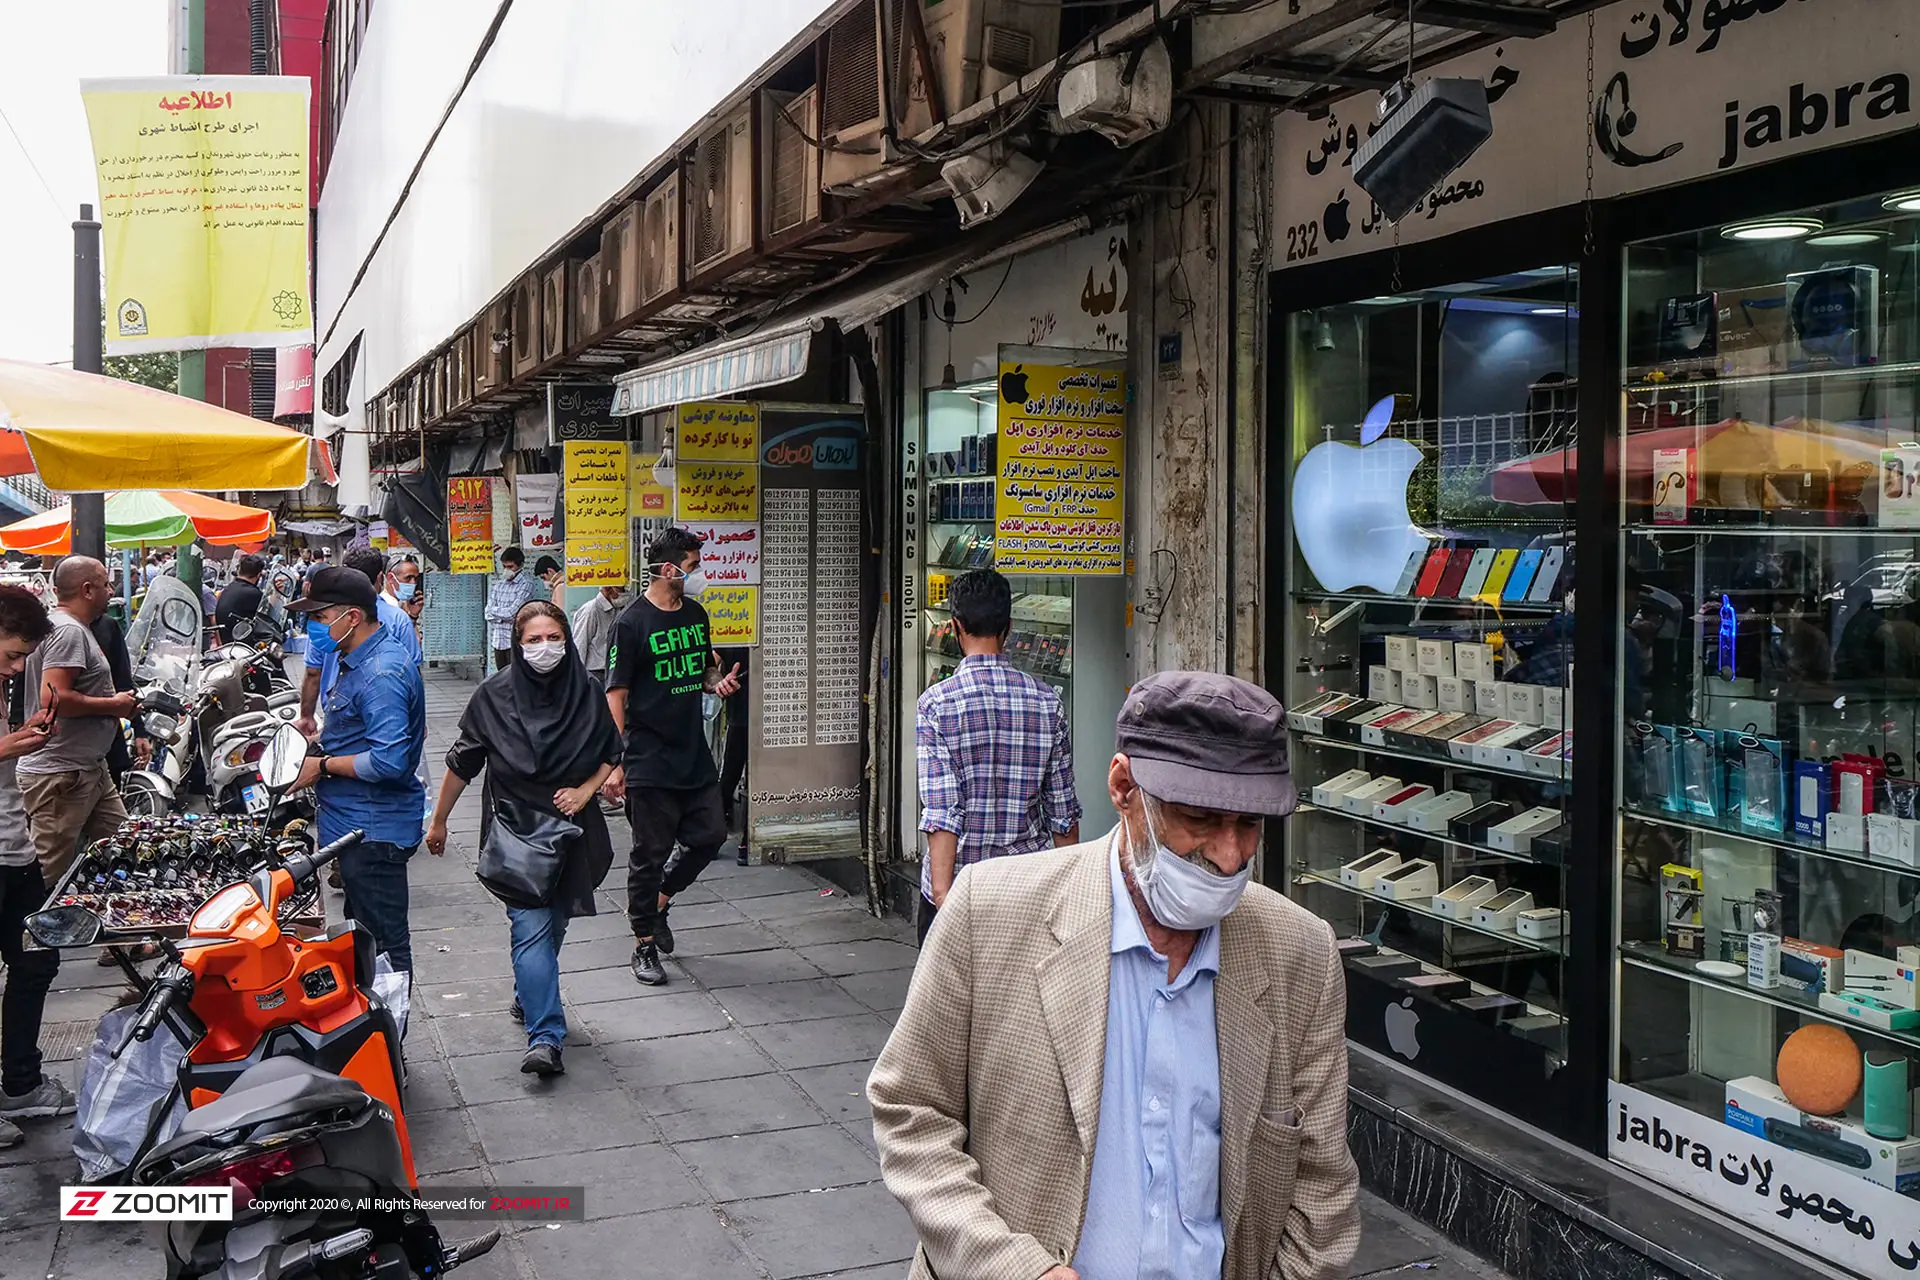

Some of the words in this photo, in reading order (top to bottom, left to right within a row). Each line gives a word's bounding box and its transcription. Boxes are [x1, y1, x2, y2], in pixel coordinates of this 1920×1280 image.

[159, 91, 231, 115] اطلاعیه
[1718, 72, 1912, 169] jabra
[138, 124, 165, 137] شهری
[204, 121, 224, 134] طرح
[229, 121, 258, 134] اجرای
[1287, 221, 1318, 262] 232
[1058, 371, 1088, 391] تخصصی
[1025, 394, 1046, 415] فوری
[1047, 395, 1065, 416] افزار
[1066, 398, 1079, 417] نرم
[683, 408, 716, 425] گوشی
[718, 409, 755, 426] معاوضه
[559, 418, 622, 438] فوری
[1006, 421, 1024, 437] اپل
[1026, 424, 1062, 438] افزاری
[1065, 424, 1083, 440] نرم
[1086, 424, 1122, 439] خدمات
[731, 433, 740, 448] با
[742, 433, 753, 449] نو
[573, 447, 597, 457] تخصصی
[598, 446, 622, 458] تعمیرات
[1020, 441, 1040, 454] آیدی
[1054, 447, 1060, 456] و
[1061, 443, 1076, 456] کلود
[1090, 443, 1108, 455] حذف
[579, 459, 607, 469] ضمانت
[610, 458, 616, 469] با
[1002, 461, 1021, 477] افزار
[1022, 462, 1035, 478] نرم
[596, 472, 618, 482] قطعات
[621, 473, 626, 482] با
[692, 468, 716, 480] فروش
[718, 472, 723, 481] و
[724, 469, 745, 481] خرید
[1056, 469, 1061, 478] و
[1062, 463, 1083, 479] آیدی
[1099, 464, 1121, 478] ساخت
[569, 473, 594, 484] اصلی
[450, 479, 483, 499] ۰۹۱۲
[1005, 481, 1043, 500] سامسونگ
[1044, 483, 1072, 502] افزاری
[1073, 485, 1087, 502] نرم
[1088, 485, 1116, 500] خدمات
[577, 495, 597, 505] فروش
[597, 497, 602, 505] و
[603, 496, 618, 505] خرید
[904, 441, 917, 560] SAMSUNG
[594, 508, 608, 518] های
[608, 507, 628, 518] گوشی
[687, 501, 709, 513] قیمت
[709, 502, 740, 514] بالاترین
[741, 503, 749, 513] به
[1054, 507, 1059, 516] و
[1061, 503, 1077, 514] FRP
[402, 515, 445, 556] NOKIA
[998, 538, 1022, 549] FLASH
[1029, 540, 1047, 549] ROM
[702, 550, 721, 562] سخت
[722, 555, 727, 564] و
[728, 550, 745, 565] افزار
[746, 550, 759, 564] نرم
[568, 569, 595, 583] تعویض
[597, 569, 622, 579] ضمانت
[717, 567, 740, 580] قطعات
[741, 568, 748, 582] با
[726, 591, 749, 604] انواع
[904, 575, 917, 629] mobile
[716, 626, 741, 636] ضمانت
[744, 625, 752, 637] با
[763, 624, 779, 633] 0912
[779, 624, 791, 633] 016
[649, 624, 707, 655] GAME
[763, 658, 779, 668] 0912
[779, 658, 787, 668] 09
[787, 658, 796, 668] 09
[763, 737, 779, 746] 0912
[751, 790, 768, 806] کارت
[785, 788, 808, 804] فروش
[1617, 1104, 1713, 1172] jabra
[1720, 1152, 1876, 1240] محصولات
